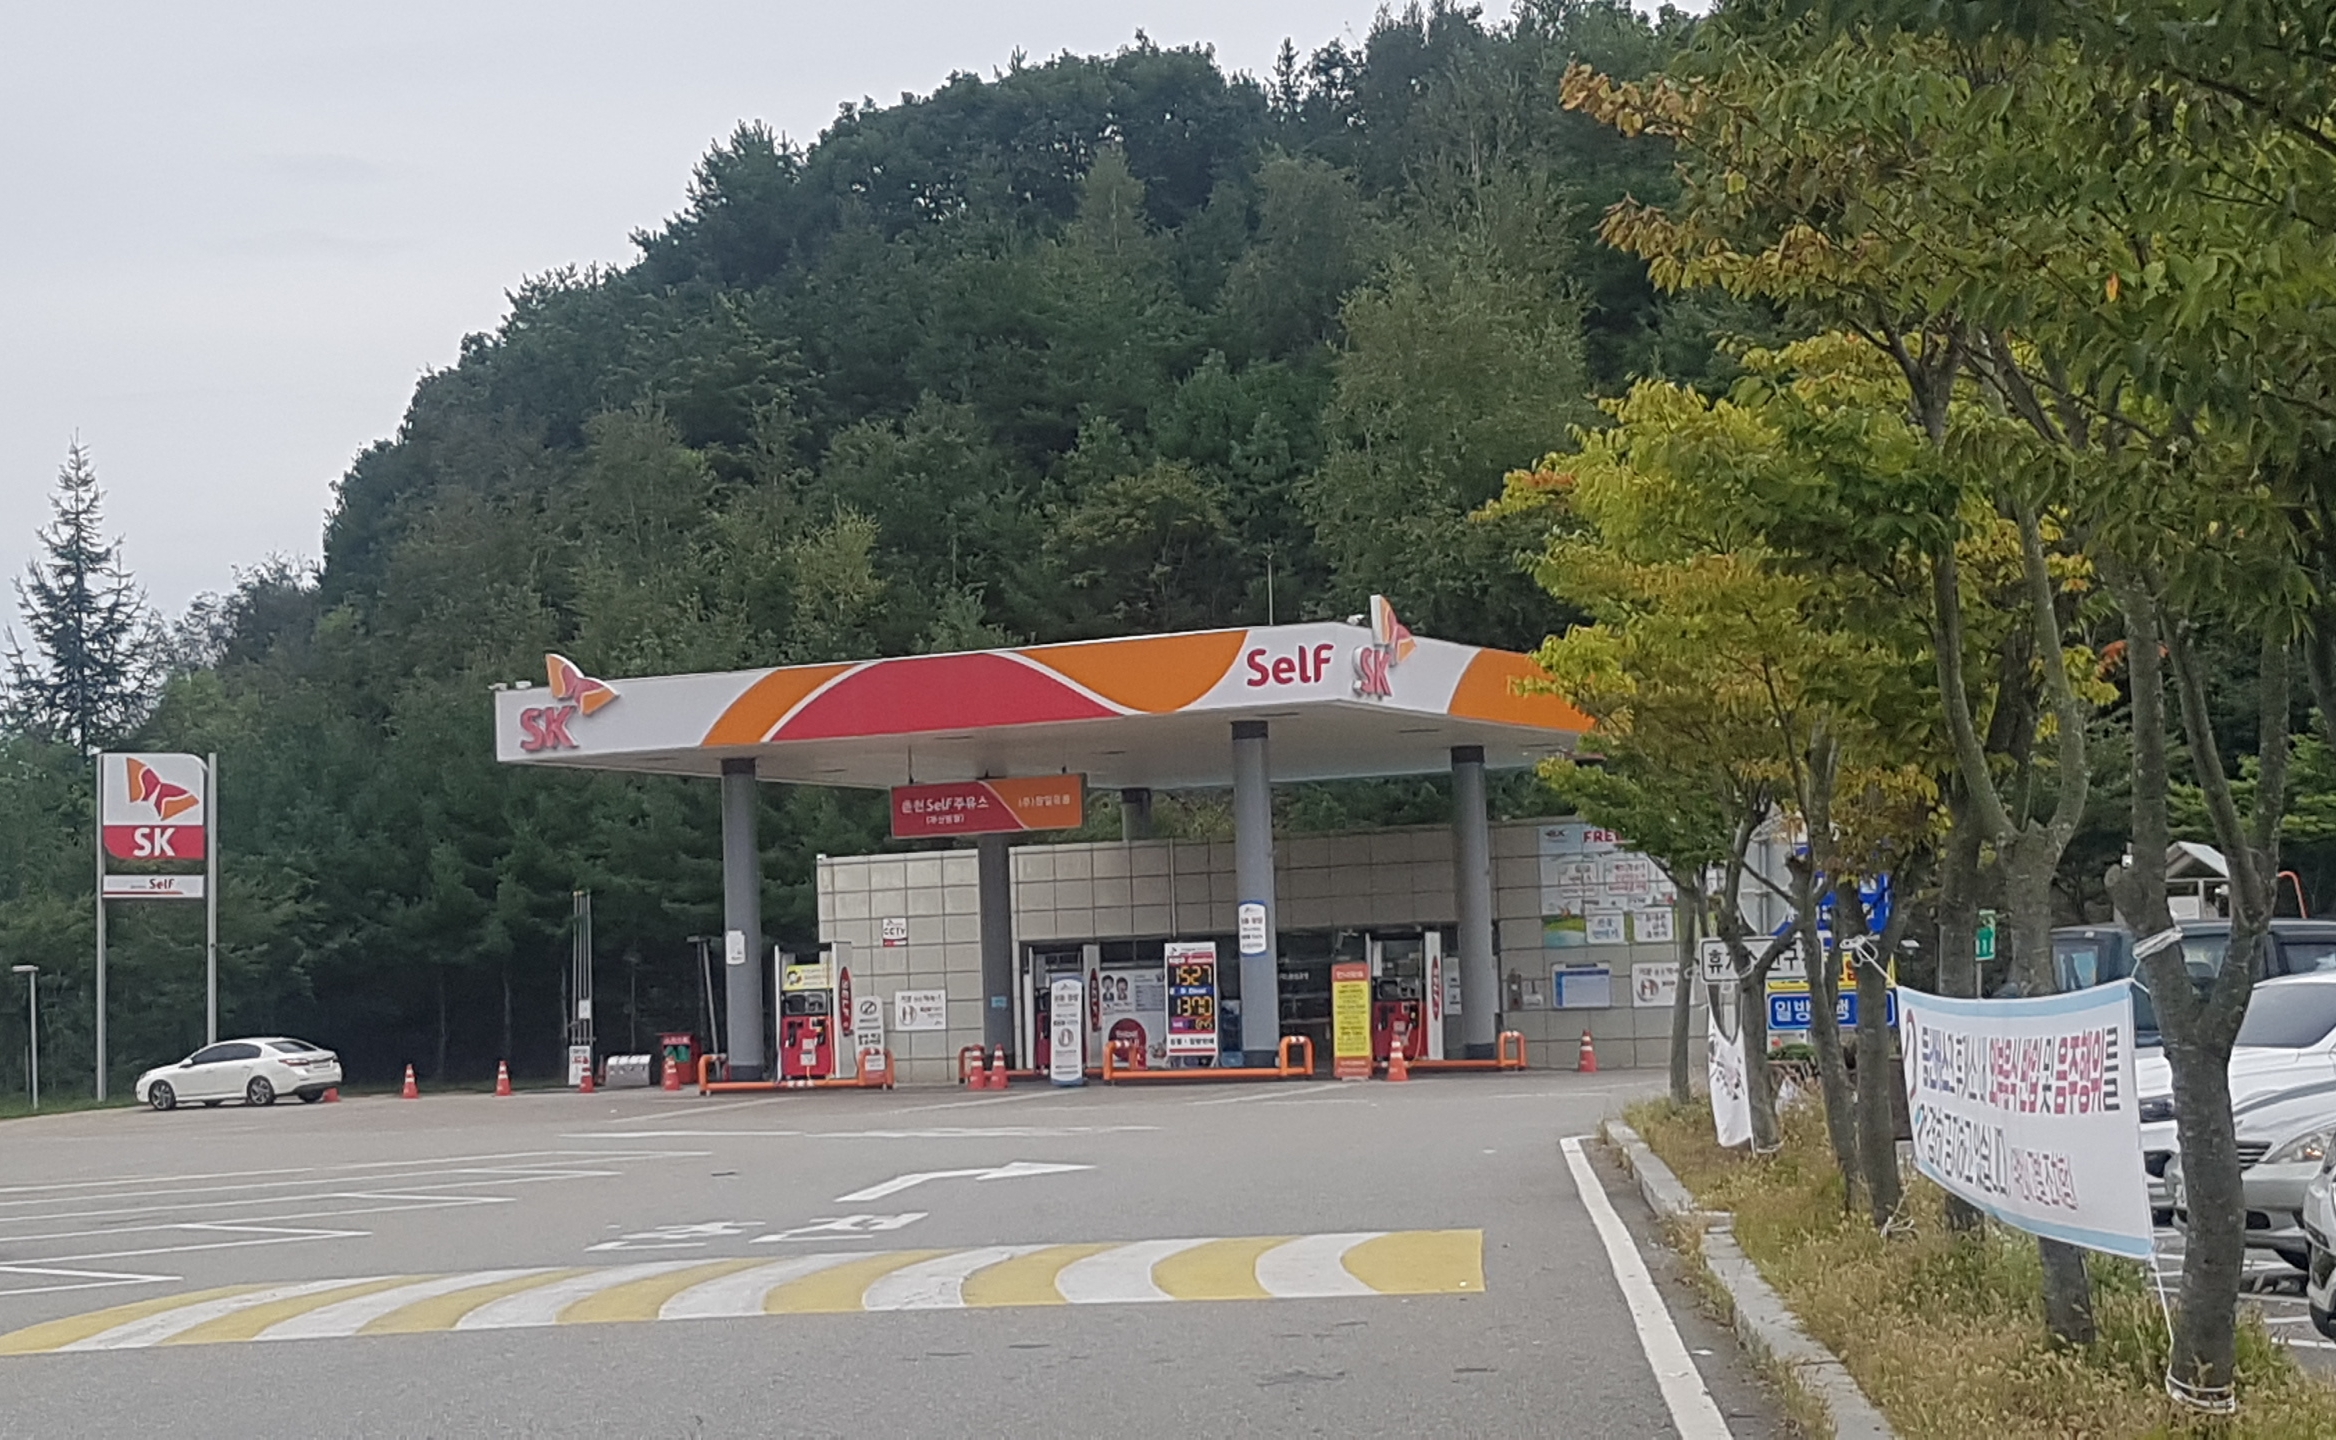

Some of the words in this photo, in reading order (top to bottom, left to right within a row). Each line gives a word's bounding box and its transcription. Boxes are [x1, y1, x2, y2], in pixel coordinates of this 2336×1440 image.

[1246, 643, 1334, 687] Self
[1353, 646, 1392, 698] SK
[520, 705, 578, 752] SK
[133, 827, 176, 858] SK
[149, 878, 175, 890] Self
[883, 926, 906, 937] CCTV
[1175, 964, 1213, 986] 1527
[1775, 998, 1850, 1022] 일방행
[2054, 1026, 2121, 1115] 음주행위를
